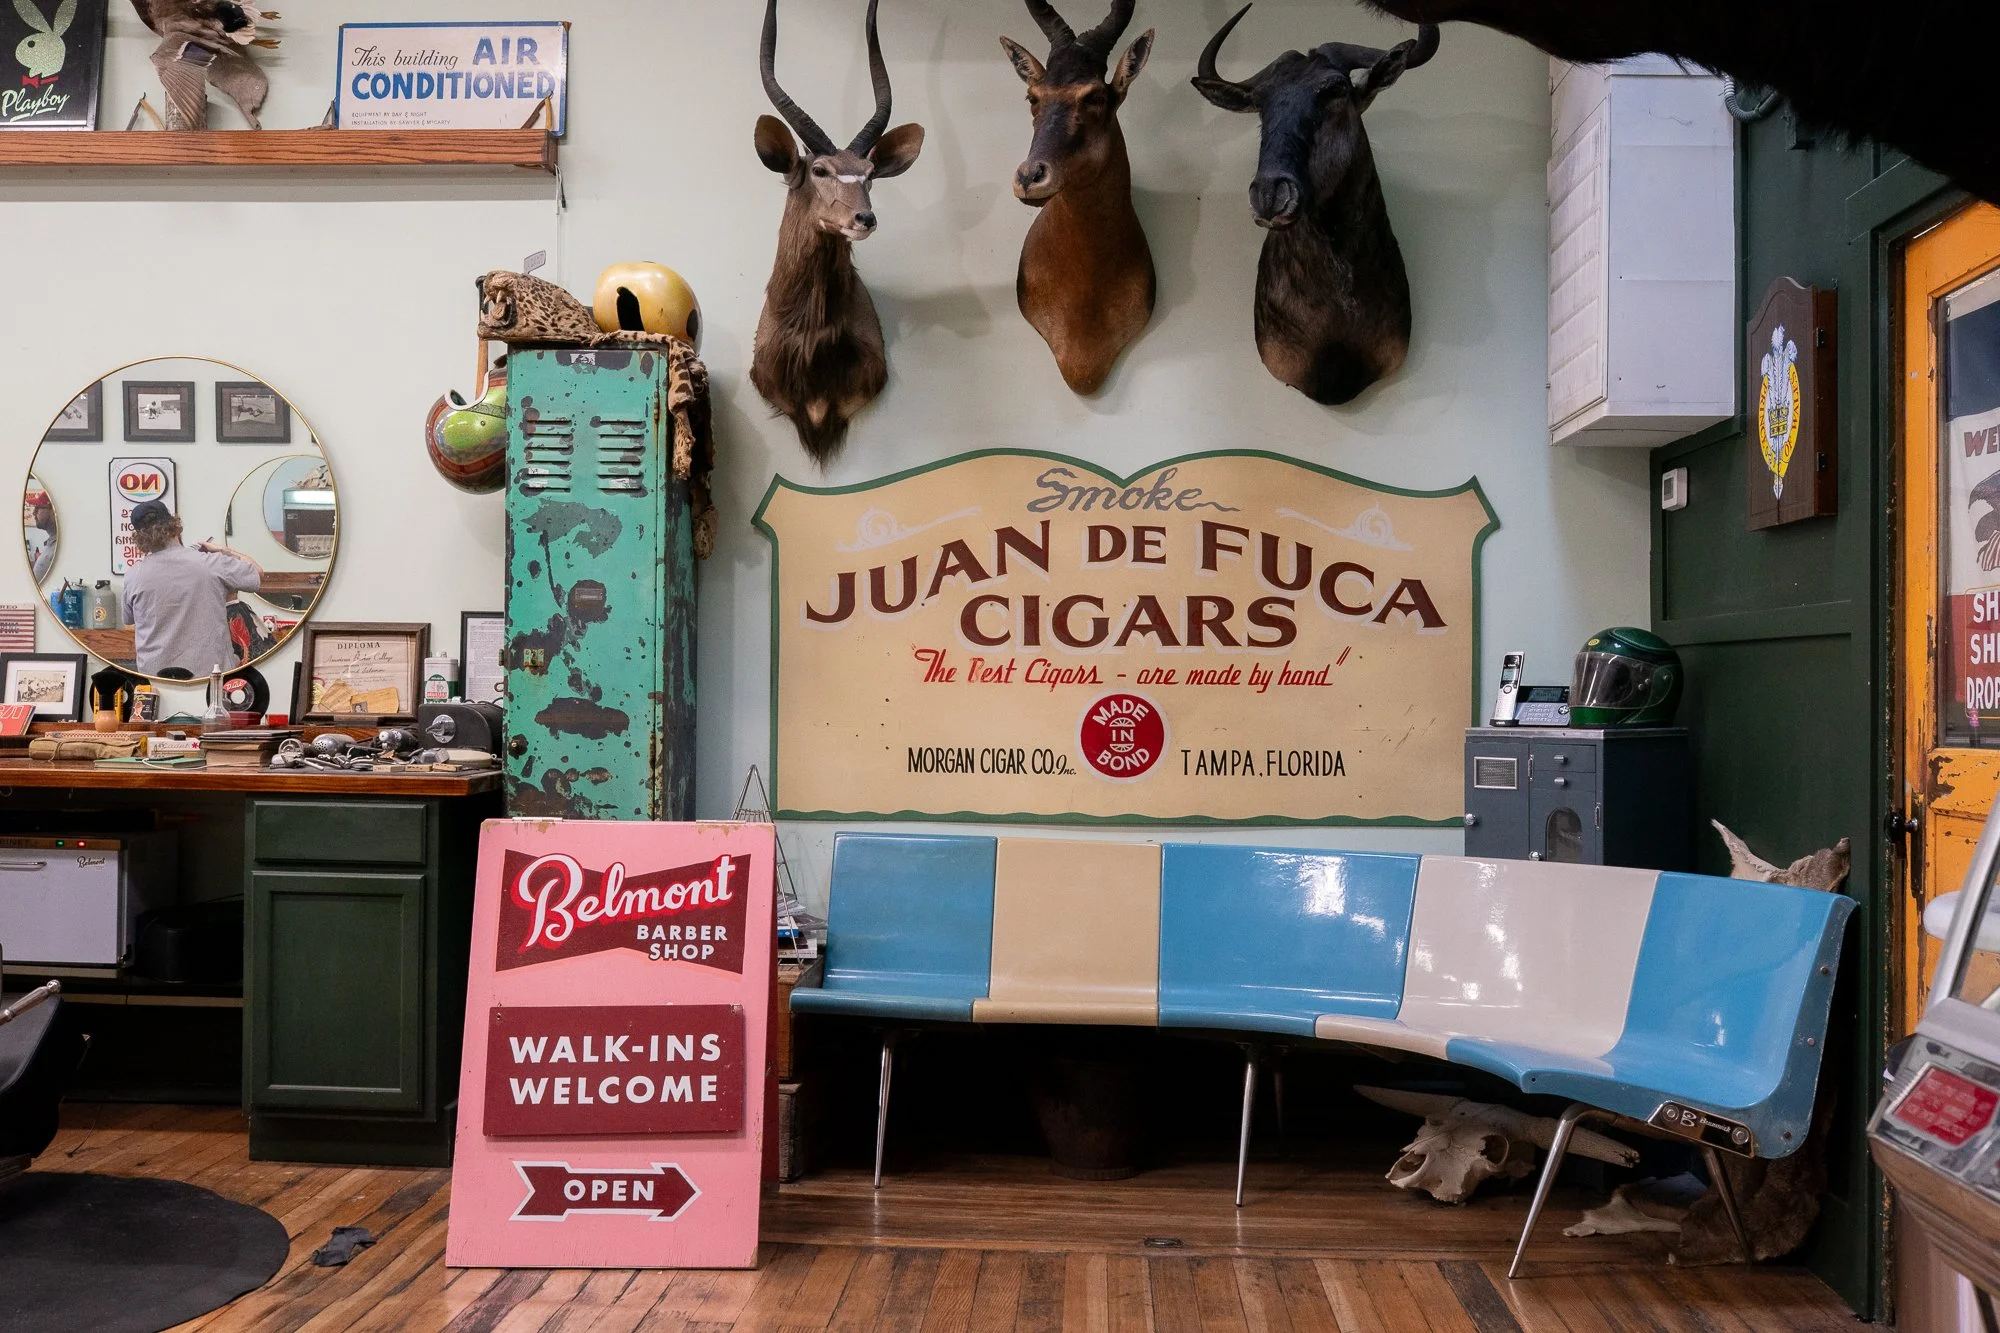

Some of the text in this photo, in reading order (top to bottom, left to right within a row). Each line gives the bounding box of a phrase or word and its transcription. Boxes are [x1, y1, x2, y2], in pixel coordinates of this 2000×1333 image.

[351, 46, 458, 70] This building
[472, 36, 540, 65] AIR
[351, 71, 556, 100] CONDITIONED
[2, 84, 70, 117] Playboy
[1964, 424, 2000, 457] WE
[1026, 467, 1241, 513] Smoke
[805, 519, 1448, 629] JUAN DE FUCA
[960, 594, 1298, 649] CIGARS
[337, 642, 381, 650] DIPLOMA
[1024, 658, 1104, 693] Cigars
[1136, 667, 1180, 685] are
[1185, 664, 1242, 686] made
[1248, 662, 1274, 694] by
[1092, 699, 1149, 726] MADE
[1112, 729, 1135, 742] IN
[907, 747, 975, 774] MORGAN
[980, 748, 1028, 775] CIGAR
[1096, 748, 1151, 771] BOND
[1266, 750, 1346, 777] FLORIDA
[517, 852, 736, 949] Belmont
[637, 924, 728, 942] BARBER
[648, 943, 715, 961] SHOP
[508, 1033, 722, 1065] WALK-INS
[509, 1075, 718, 1105] WELCOME
[563, 1179, 655, 1202] OPEN
